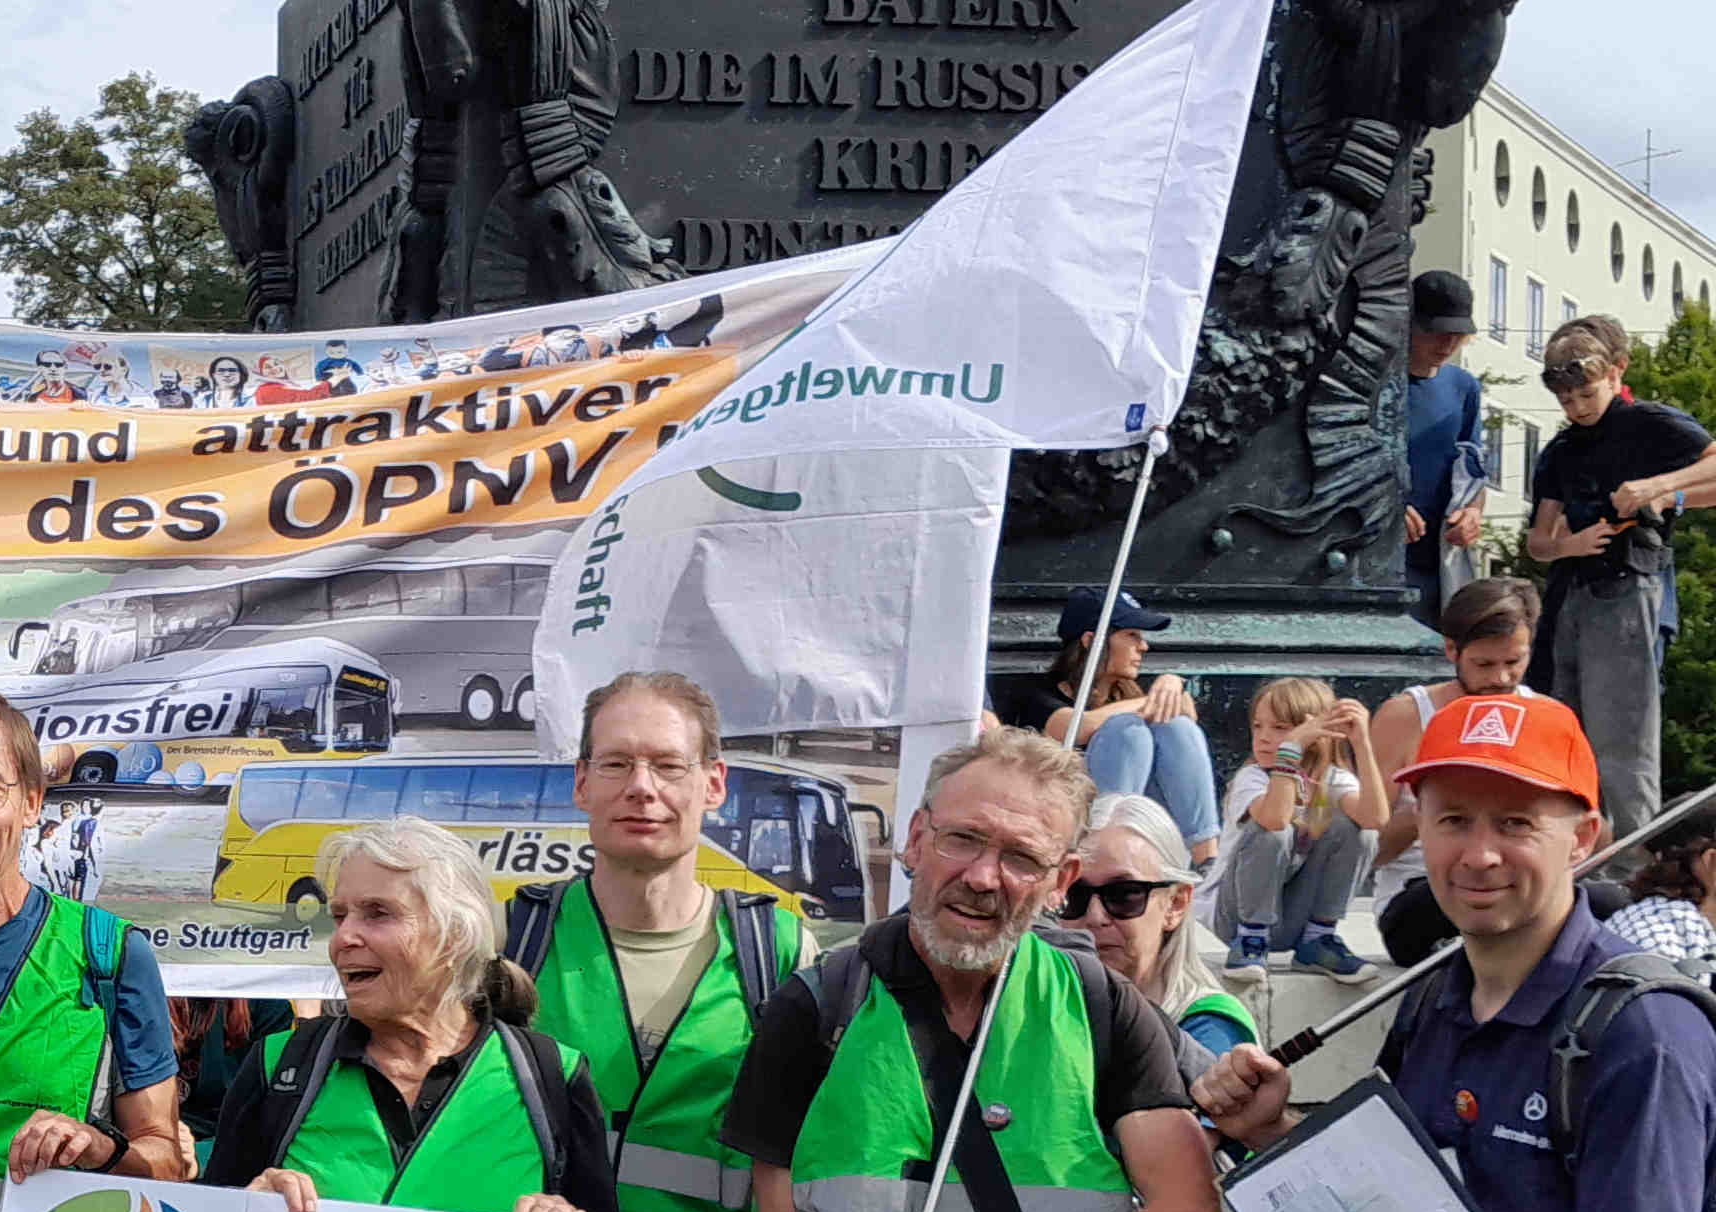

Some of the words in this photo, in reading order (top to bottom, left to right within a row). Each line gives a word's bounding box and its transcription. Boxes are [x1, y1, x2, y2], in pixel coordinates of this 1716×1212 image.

[634, 49, 744, 103] DIE
[770, 52, 859, 105] IM
[679, 219, 807, 272] DEN
[192, 376, 672, 455] attraktiver
[28, 480, 223, 543] des
[269, 430, 627, 540] ÖPNV
[179, 923, 310, 955] Stuttgart
